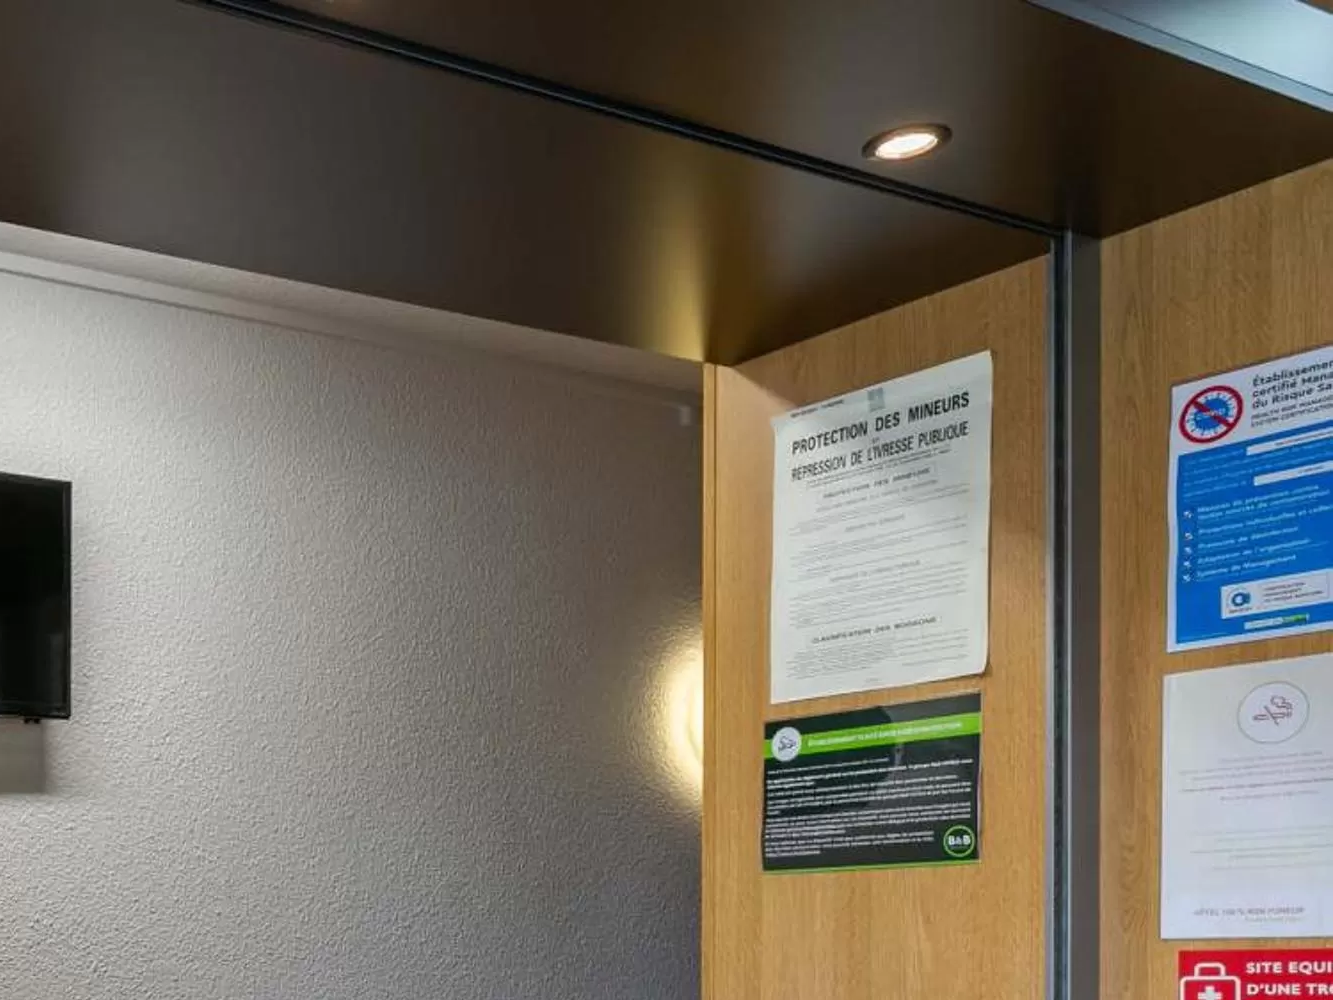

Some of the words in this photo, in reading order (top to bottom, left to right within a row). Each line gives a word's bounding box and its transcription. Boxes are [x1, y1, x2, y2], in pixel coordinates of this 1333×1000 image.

[791, 421, 868, 455] PROTECTION
[875, 411, 901, 432] DES
[907, 391, 970, 424] MINEURS
[850, 449, 864, 467] DE
[917, 420, 969, 448] PUBLIQUE
[1246, 961, 1283, 974] SITE
[1246, 983, 1302, 996] D'UNE
